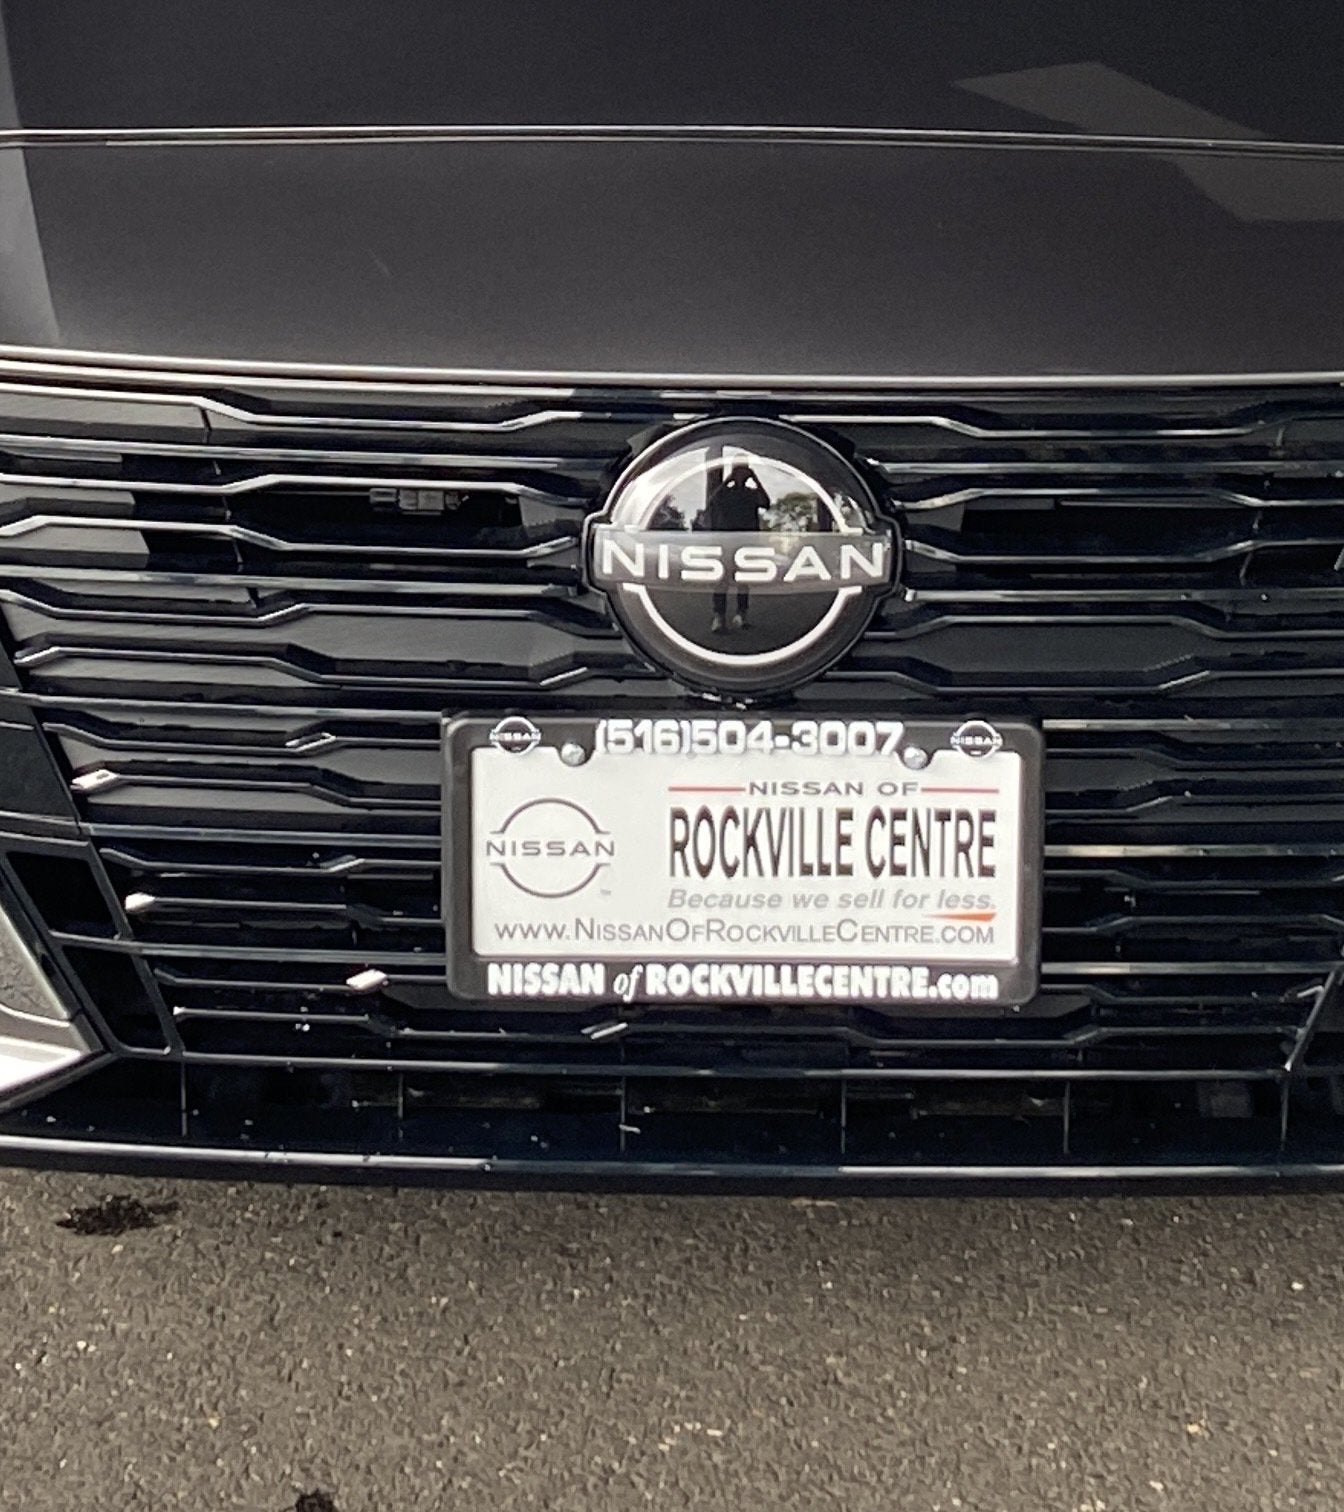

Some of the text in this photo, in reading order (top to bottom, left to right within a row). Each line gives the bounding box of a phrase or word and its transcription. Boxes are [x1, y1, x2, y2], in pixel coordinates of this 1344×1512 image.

[602, 538, 883, 582] NISSAN
[595, 718, 904, 756] (516)504-3007
[749, 781, 919, 796] NISSAN OF
[486, 840, 615, 857] NISSAN
[669, 804, 998, 879] ROCKVILLE CENTRE
[667, 888, 997, 910] Because we sell for less.
[487, 962, 999, 1003] NISSAN of ROCKVILLECENTRE.com
